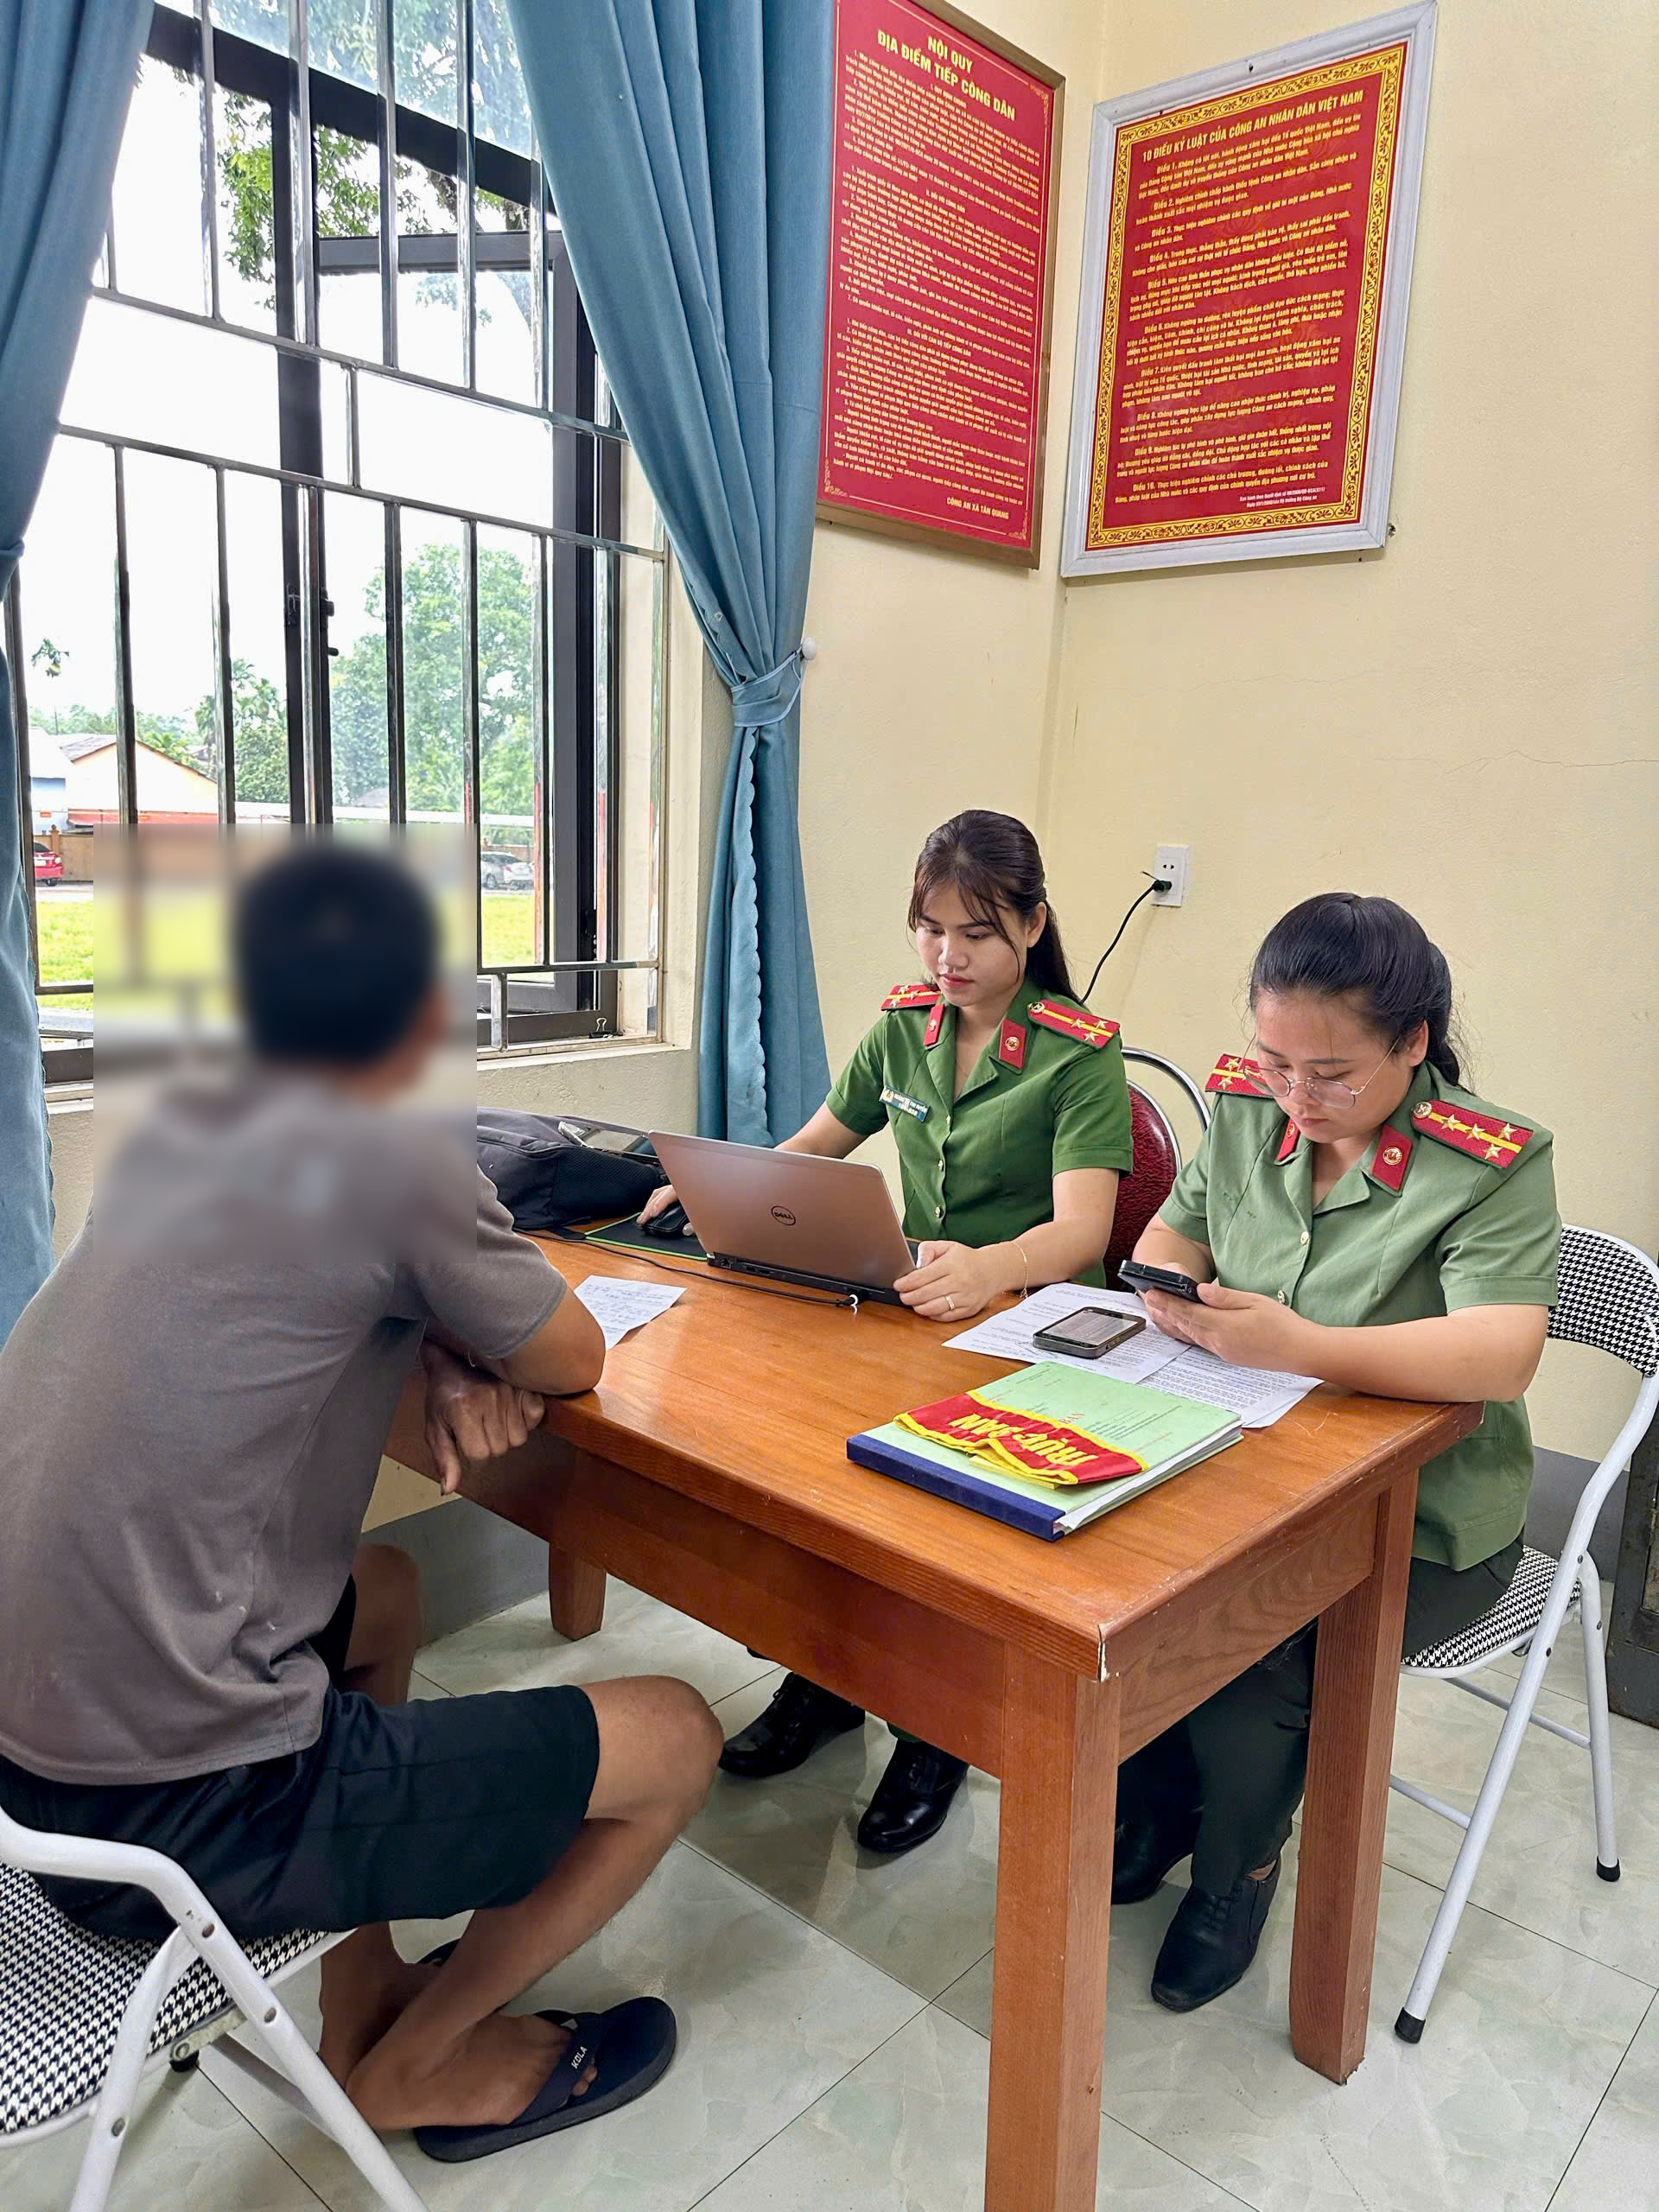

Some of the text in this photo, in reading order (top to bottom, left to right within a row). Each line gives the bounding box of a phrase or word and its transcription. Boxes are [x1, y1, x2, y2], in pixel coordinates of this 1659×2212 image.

[877, 29, 1014, 120] ĐỊA ĐIỂM TIẾP CÔNG DÂN
[927, 35, 972, 73] NỘI QUY
[1142, 89, 1363, 162] 10 ĐIỀU KỶ LUẬT CỦA CÔNG AN NHÂN DÂN VIỆT NAM
[946, 497, 1008, 518] CÔNG AN XÃ TÂN QUANG
